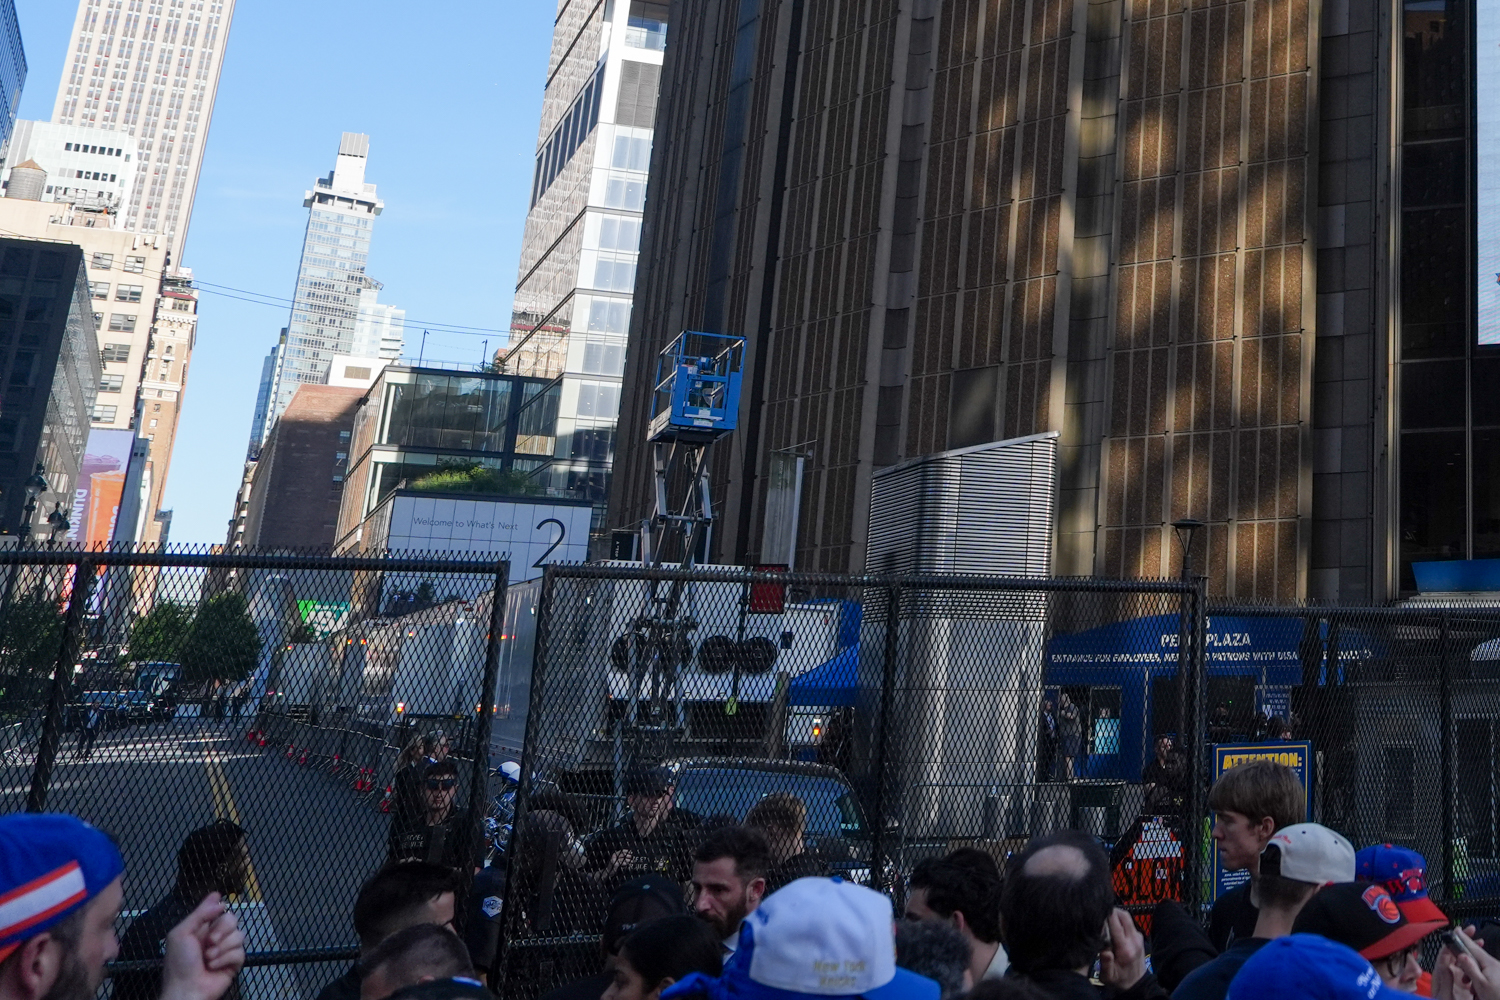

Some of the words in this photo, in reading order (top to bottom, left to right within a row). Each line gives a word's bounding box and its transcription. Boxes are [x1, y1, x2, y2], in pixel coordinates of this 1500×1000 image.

[66, 489, 88, 541] DUNKIN'
[413, 516, 452, 527] Welcome
[455, 519, 464, 528] to
[466, 520, 495, 530] What's
[497, 521, 518, 531] Next
[532, 518, 566, 568] 2
[1205, 632, 1252, 647] PLAZA
[813, 961, 839, 972] New
[844, 960, 866, 972] York
